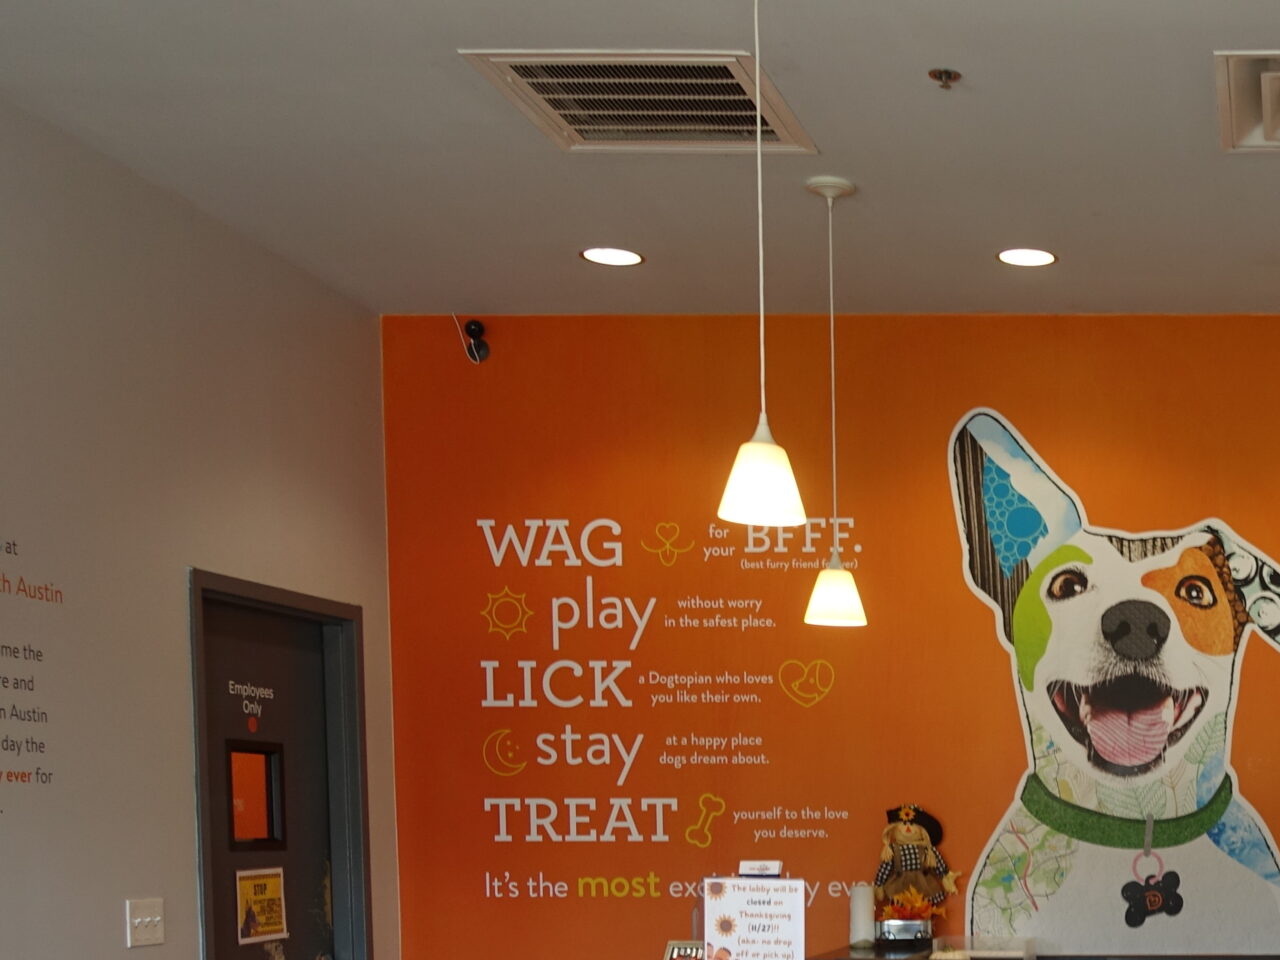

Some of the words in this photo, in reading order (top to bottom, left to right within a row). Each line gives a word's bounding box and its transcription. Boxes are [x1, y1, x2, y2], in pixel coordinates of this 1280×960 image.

[709, 524, 729, 539] for
[5, 541, 18, 556] at
[476, 519, 623, 567] WAG
[703, 546, 736, 562] your
[741, 558, 764, 569] (best
[766, 558, 789, 572] furry
[792, 558, 820, 569] friend
[16, 576, 63, 605] Austin
[552, 576, 657, 650] play
[678, 595, 724, 609] without
[727, 599, 762, 613] worry
[664, 614, 676, 627] in
[680, 614, 700, 627] the
[703, 614, 738, 627] safest
[741, 614, 776, 632] place.
[23, 644, 43, 662] the
[13, 676, 34, 691] and
[481, 660, 633, 707] LICK
[638, 675, 645, 684] a
[648, 671, 712, 689] Dogtopian
[715, 671, 740, 684] who
[744, 671, 774, 684] loves
[228, 680, 274, 700] Employees
[651, 693, 673, 707] you
[676, 690, 698, 703] like
[701, 690, 730, 703] their
[733, 693, 761, 703] own.
[10, 703, 48, 723] Austin
[242, 700, 262, 717] Only
[1, 734, 22, 756] day
[25, 736, 45, 754] the
[665, 734, 678, 746] at
[681, 736, 687, 746] a
[691, 732, 728, 750] happy
[731, 732, 763, 749] place
[535, 724, 644, 786] stay
[659, 751, 687, 769] dogs
[690, 751, 728, 764] dream
[731, 751, 769, 764] about.
[6, 769, 32, 783] ever
[35, 767, 53, 784] for
[484, 798, 678, 842] TREAT
[733, 806, 783, 824] yourself
[785, 808, 798, 819] to
[801, 806, 821, 819] the
[824, 806, 849, 819] love
[753, 828, 776, 842] you
[779, 825, 829, 838] deserve.
[484, 871, 519, 897] It's
[527, 871, 568, 897] the
[577, 871, 660, 897] most
[732, 884, 747, 892] The
[749, 884, 770, 895] lobby
[789, 885, 798, 893] be
[747, 898, 772, 906] closed
[739, 911, 792, 921] Thanksgiving
[774, 936, 792, 948] drop
[763, 951, 778, 959] pick
